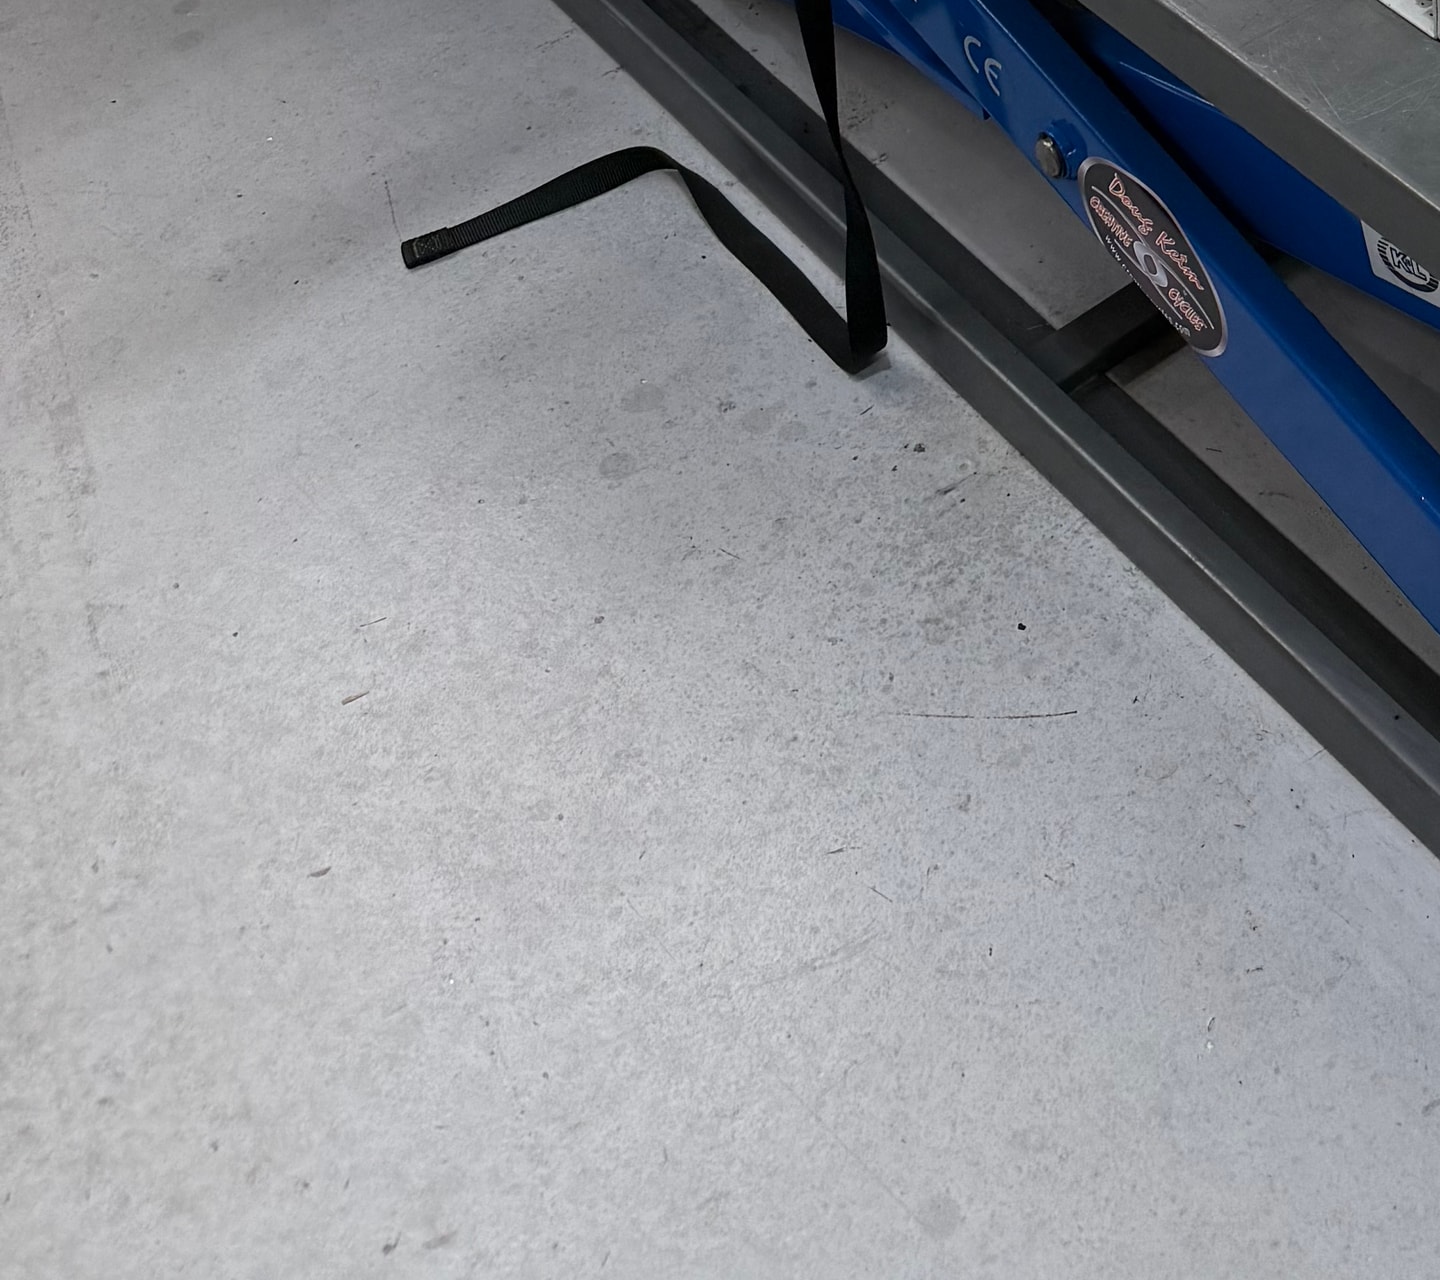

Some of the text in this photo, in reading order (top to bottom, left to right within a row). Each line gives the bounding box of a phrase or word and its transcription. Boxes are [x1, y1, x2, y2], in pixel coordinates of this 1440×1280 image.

[1108, 172, 1154, 236] Doug
[1155, 230, 1205, 291] Keim
[1389, 246, 1428, 282] K&L
[1168, 287, 1208, 332] CYCLES
